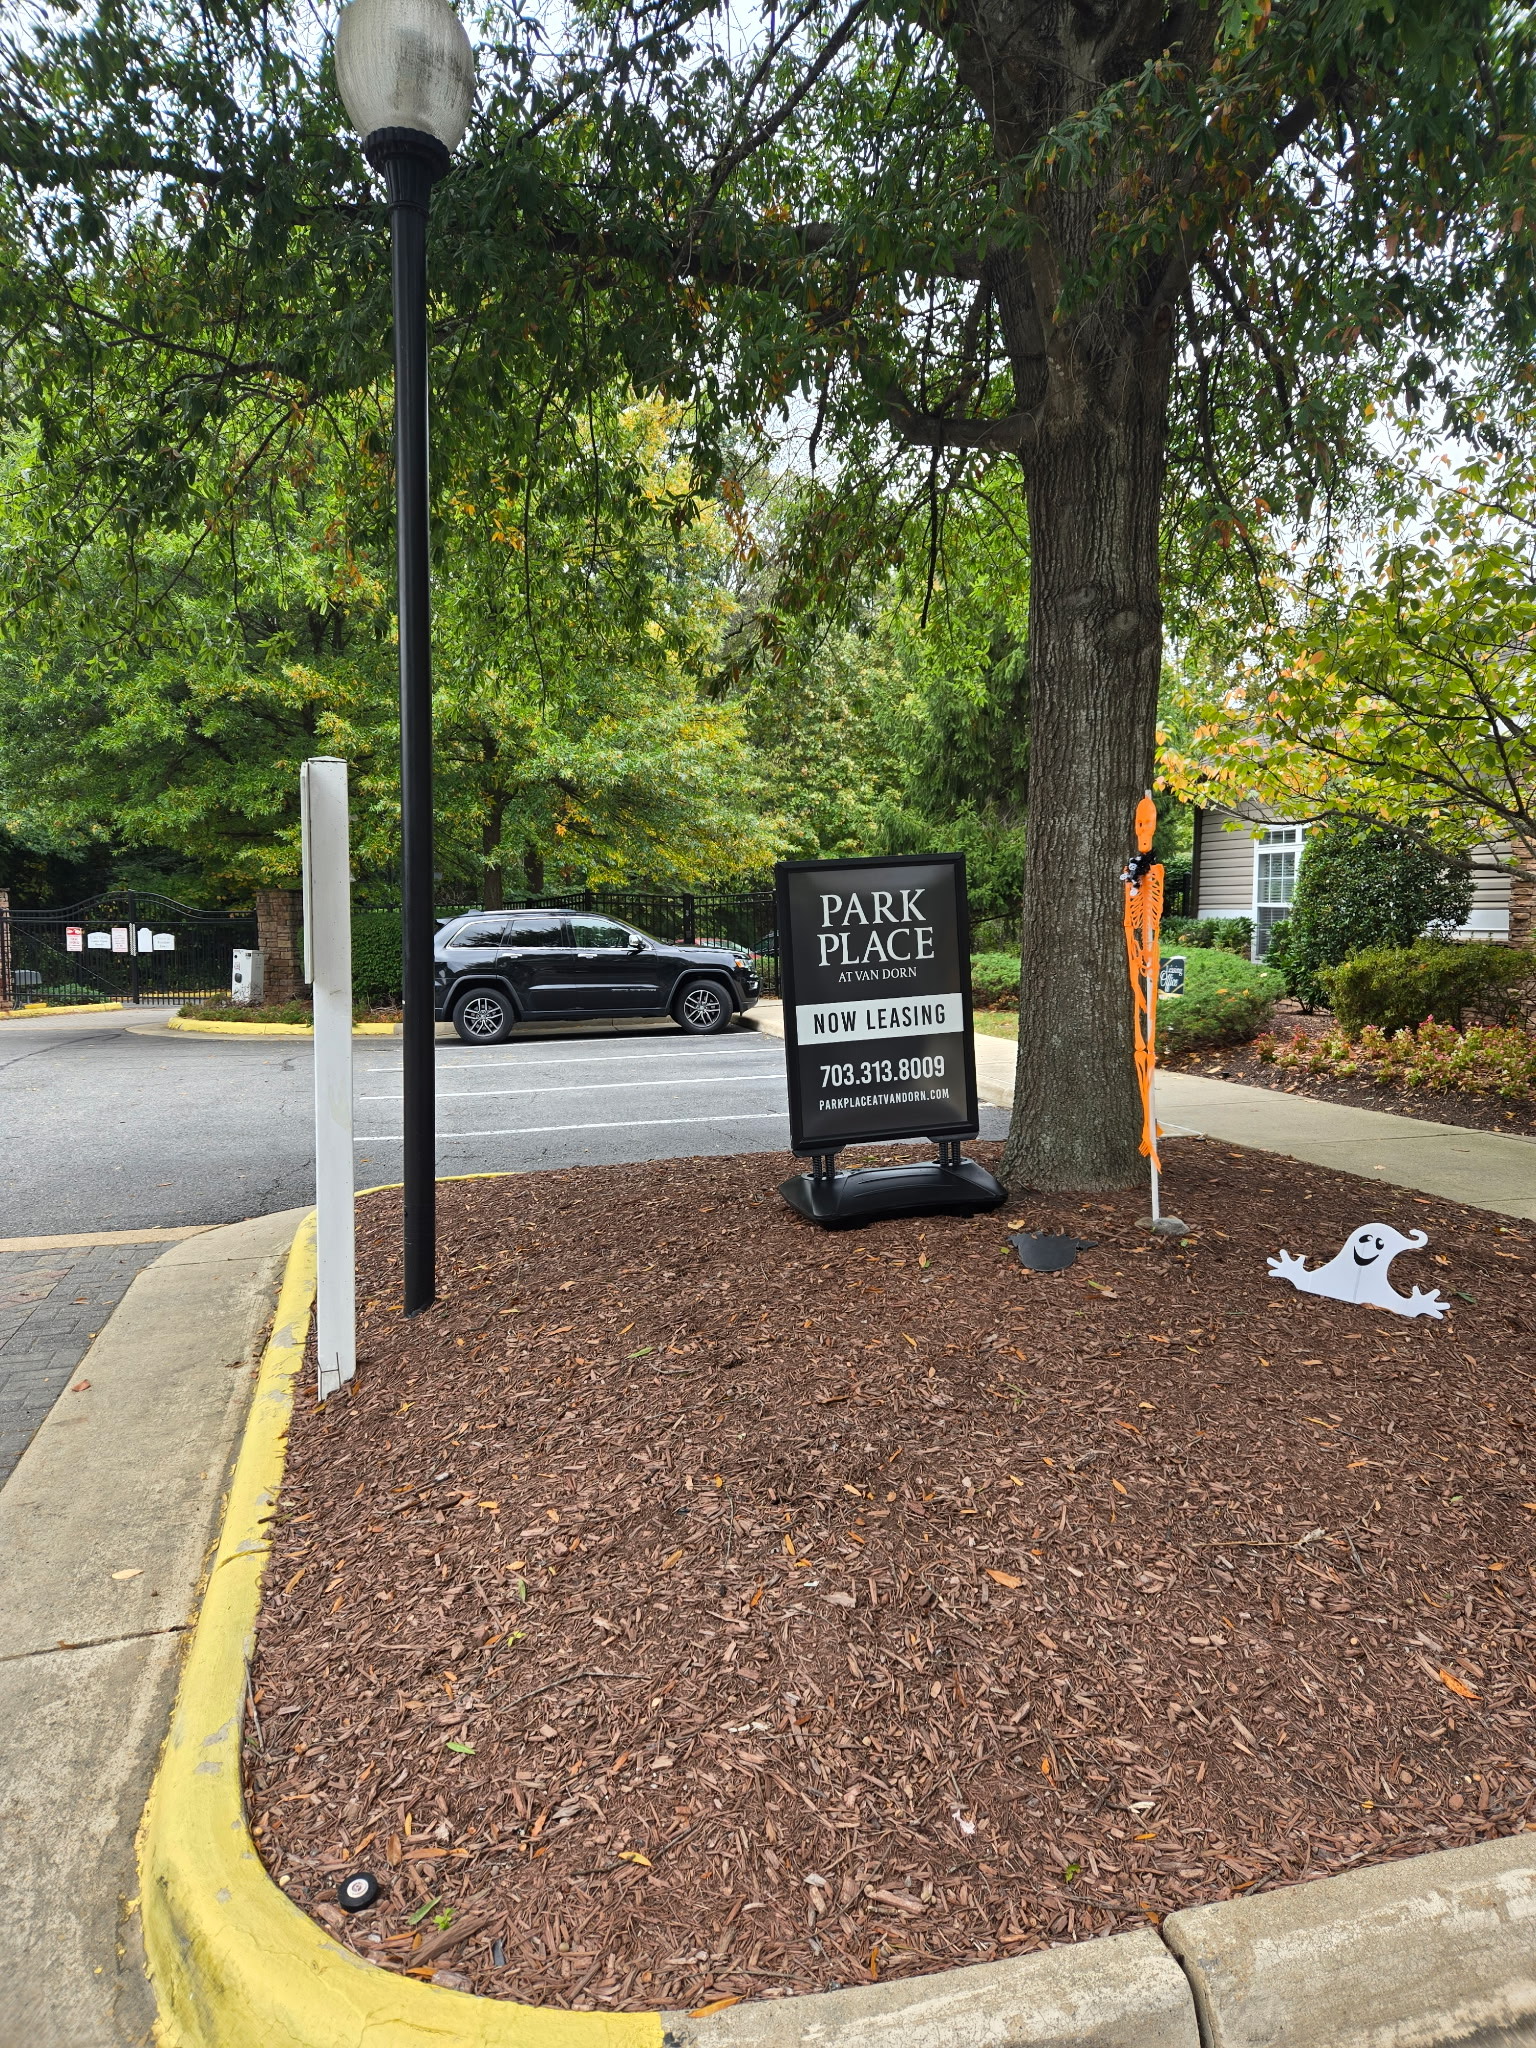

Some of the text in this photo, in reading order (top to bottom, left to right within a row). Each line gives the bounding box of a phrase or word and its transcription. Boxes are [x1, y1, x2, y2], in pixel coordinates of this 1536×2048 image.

[819, 888, 927, 928] PARK
[816, 926, 935, 967] PLACE
[838, 966, 917, 983] AT VAN DORN
[813, 1003, 946, 1035] NOW LEASING
[819, 1055, 945, 1088] 703.313.8009
[819, 1087, 950, 1111] PARKPLACEATVANDORN.COM
